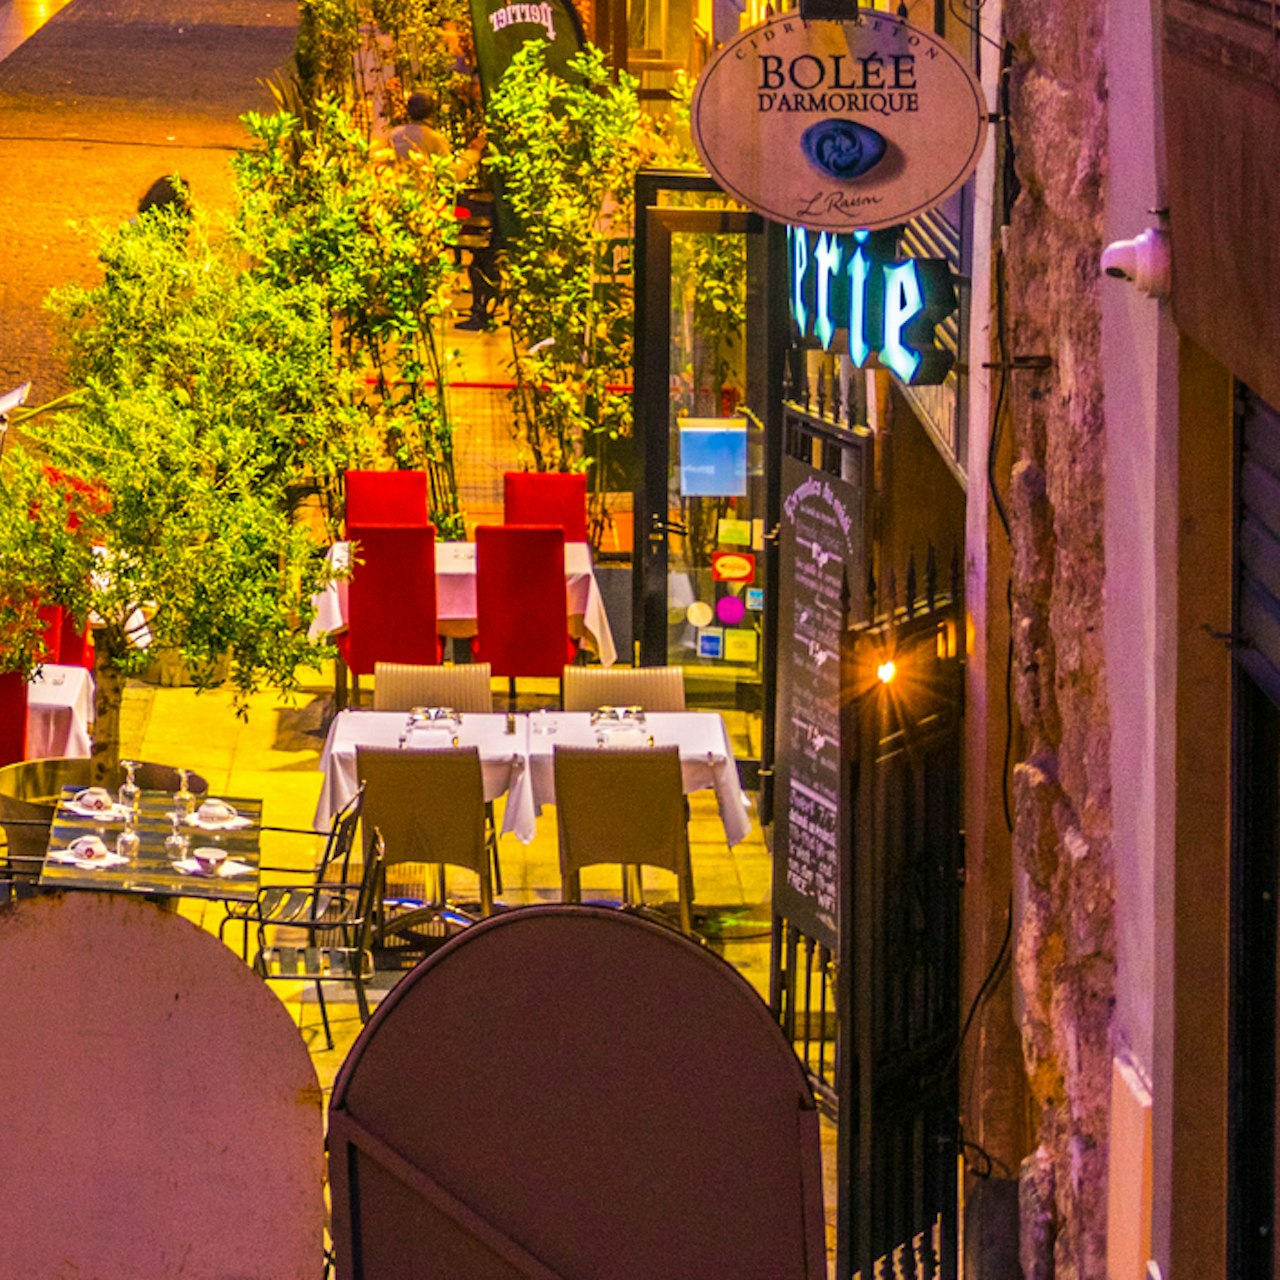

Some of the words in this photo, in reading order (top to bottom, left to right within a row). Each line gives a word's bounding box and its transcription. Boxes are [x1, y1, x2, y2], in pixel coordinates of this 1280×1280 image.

[757, 51, 917, 91] BOLÉE
[758, 92, 919, 115] D'ARMORIQUE
[786, 223, 926, 385] erie
